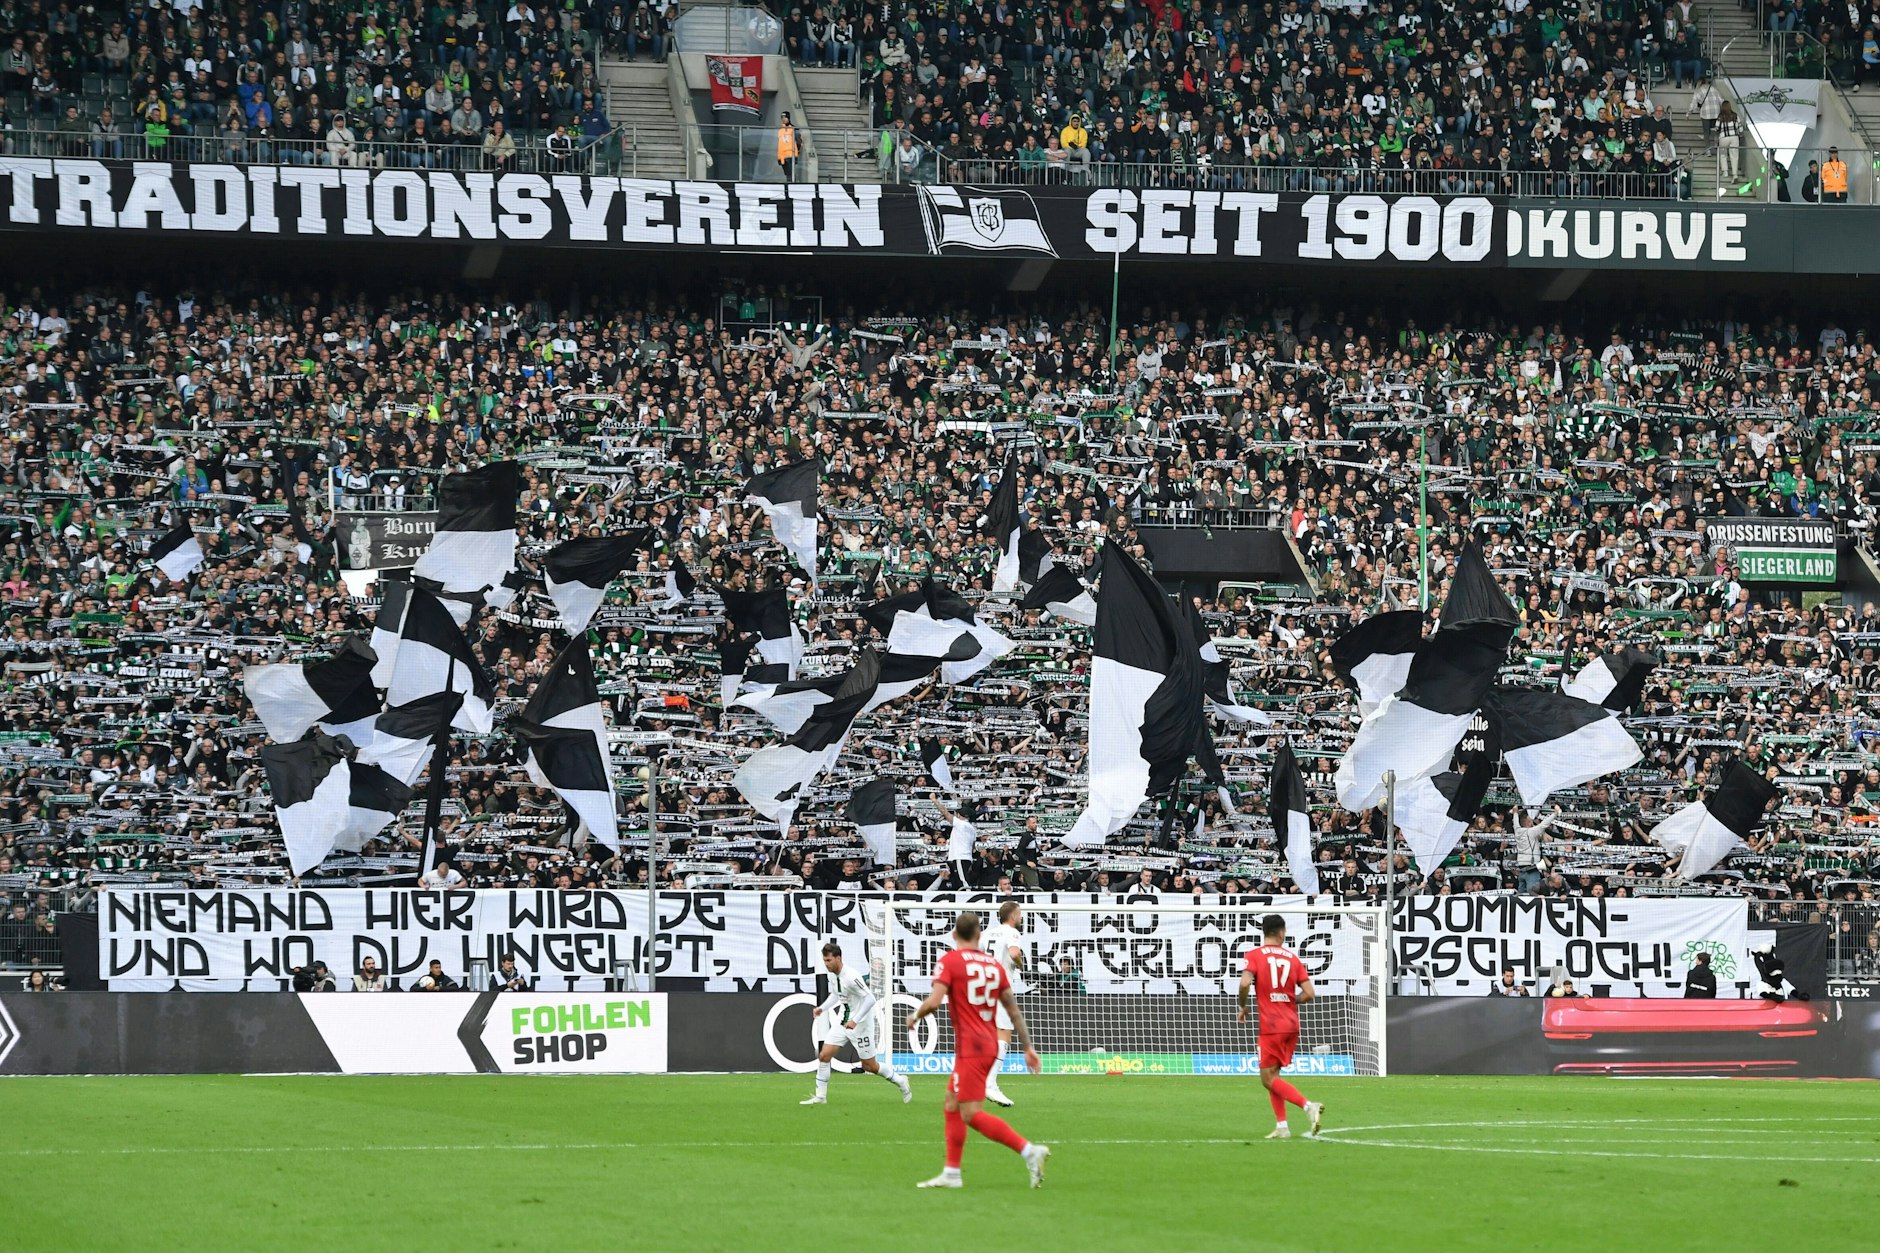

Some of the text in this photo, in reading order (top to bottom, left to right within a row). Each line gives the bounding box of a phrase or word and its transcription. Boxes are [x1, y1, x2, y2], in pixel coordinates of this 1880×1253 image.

[0, 157, 1492, 262] TRADITIONSVEREIN SEIT 1900
[1706, 524, 1834, 544] ORUSSENFESTUNG
[1742, 557, 1835, 577] SIEGERLAND
[532, 617, 563, 630] KURV
[1034, 673, 1087, 683] BORUSSIA
[1461, 735, 1485, 752] sein
[108, 892, 333, 932] NIEMAND
[365, 890, 475, 931] HIER
[509, 890, 627, 931] WIRD
[659, 891, 726, 932] JE
[1090, 894, 1160, 936] WO
[109, 936, 210, 977] UND
[243, 935, 315, 977] WO
[352, 934, 428, 976] DU
[461, 932, 731, 977] HINGEHST,
[966, 962, 1000, 1007] 22
[1267, 956, 1292, 990] 17
[511, 1000, 652, 1036] FOHLEN
[513, 1033, 608, 1065] SHOP
[857, 1036, 871, 1049] 29
